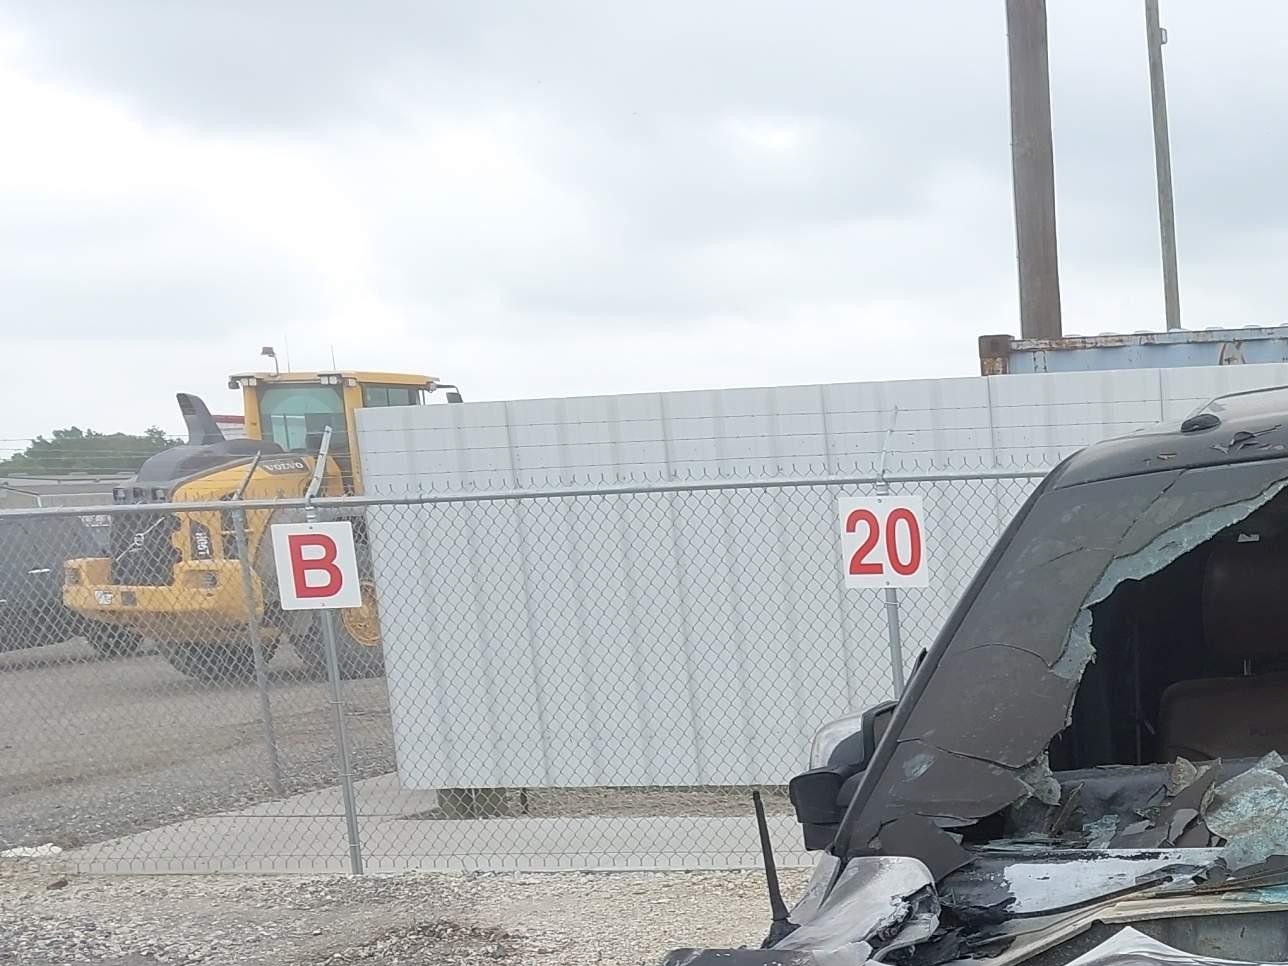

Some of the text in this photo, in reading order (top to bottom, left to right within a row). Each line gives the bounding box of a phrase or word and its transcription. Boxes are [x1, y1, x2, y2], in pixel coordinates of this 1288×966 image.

[263, 462, 304, 471] VOLVO
[287, 533, 343, 599] B
[846, 507, 922, 576] 20
